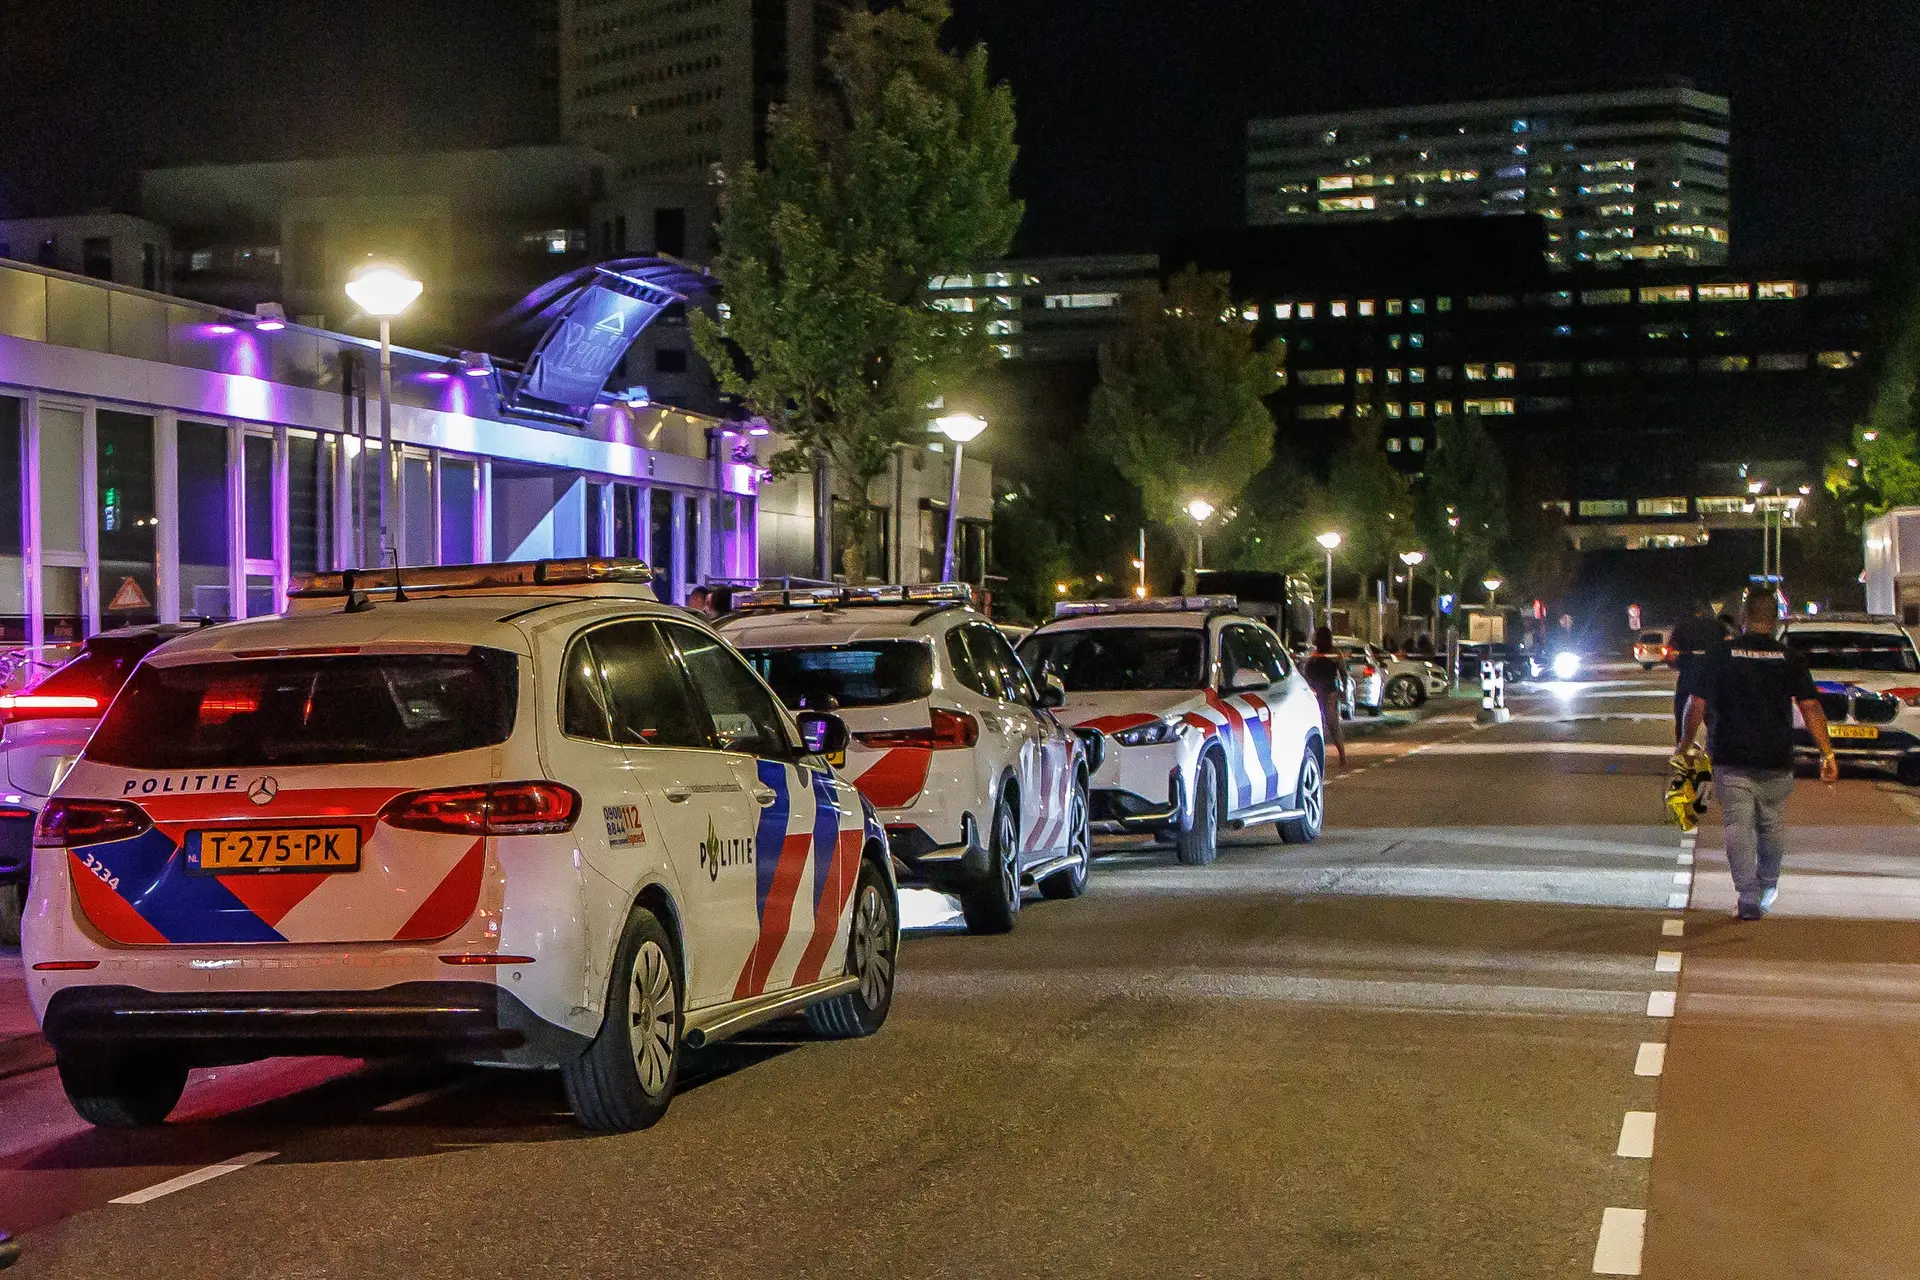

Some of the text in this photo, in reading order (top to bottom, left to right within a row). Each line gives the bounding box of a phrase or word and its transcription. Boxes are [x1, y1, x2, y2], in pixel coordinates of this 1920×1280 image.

[123, 774, 239, 795] POLITIE
[622, 806, 642, 829] 112
[188, 834, 340, 863] NL T-275-PK
[82, 853, 120, 890] 3234
